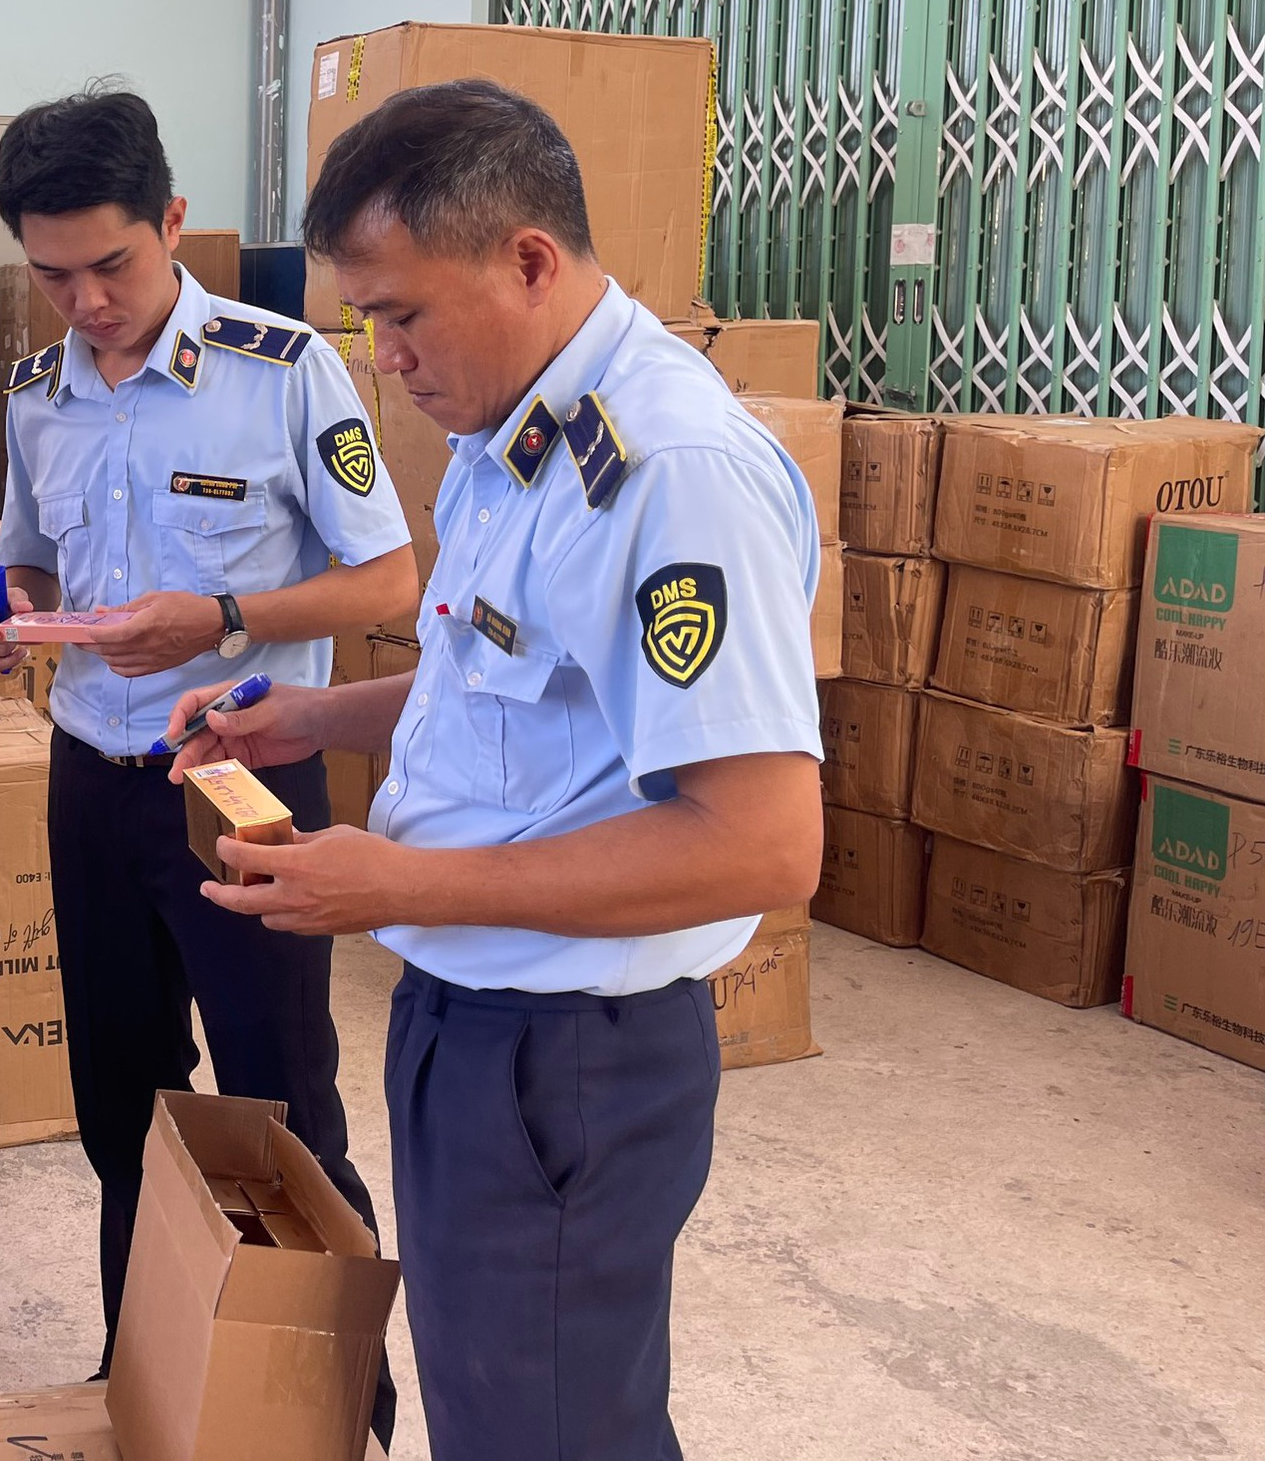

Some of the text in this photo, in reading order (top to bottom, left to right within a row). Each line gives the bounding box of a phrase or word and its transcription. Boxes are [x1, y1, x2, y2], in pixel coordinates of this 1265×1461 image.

[333, 426, 363, 447] DMS
[1156, 475, 1224, 513] OTOU
[650, 577, 697, 610] DMS
[1161, 577, 1227, 604] ADAD
[1156, 607, 1227, 632] COOL HAPPY
[1175, 629, 1204, 640] MAKE-UP
[1154, 638, 1223, 671] 酷乐潮流妆
[1158, 837, 1219, 870] ADAD
[16, 873, 42, 884] E400
[1155, 864, 1220, 898] COOL HAPPY
[4, 922, 17, 951] of
[23, 908, 56, 951] gift
